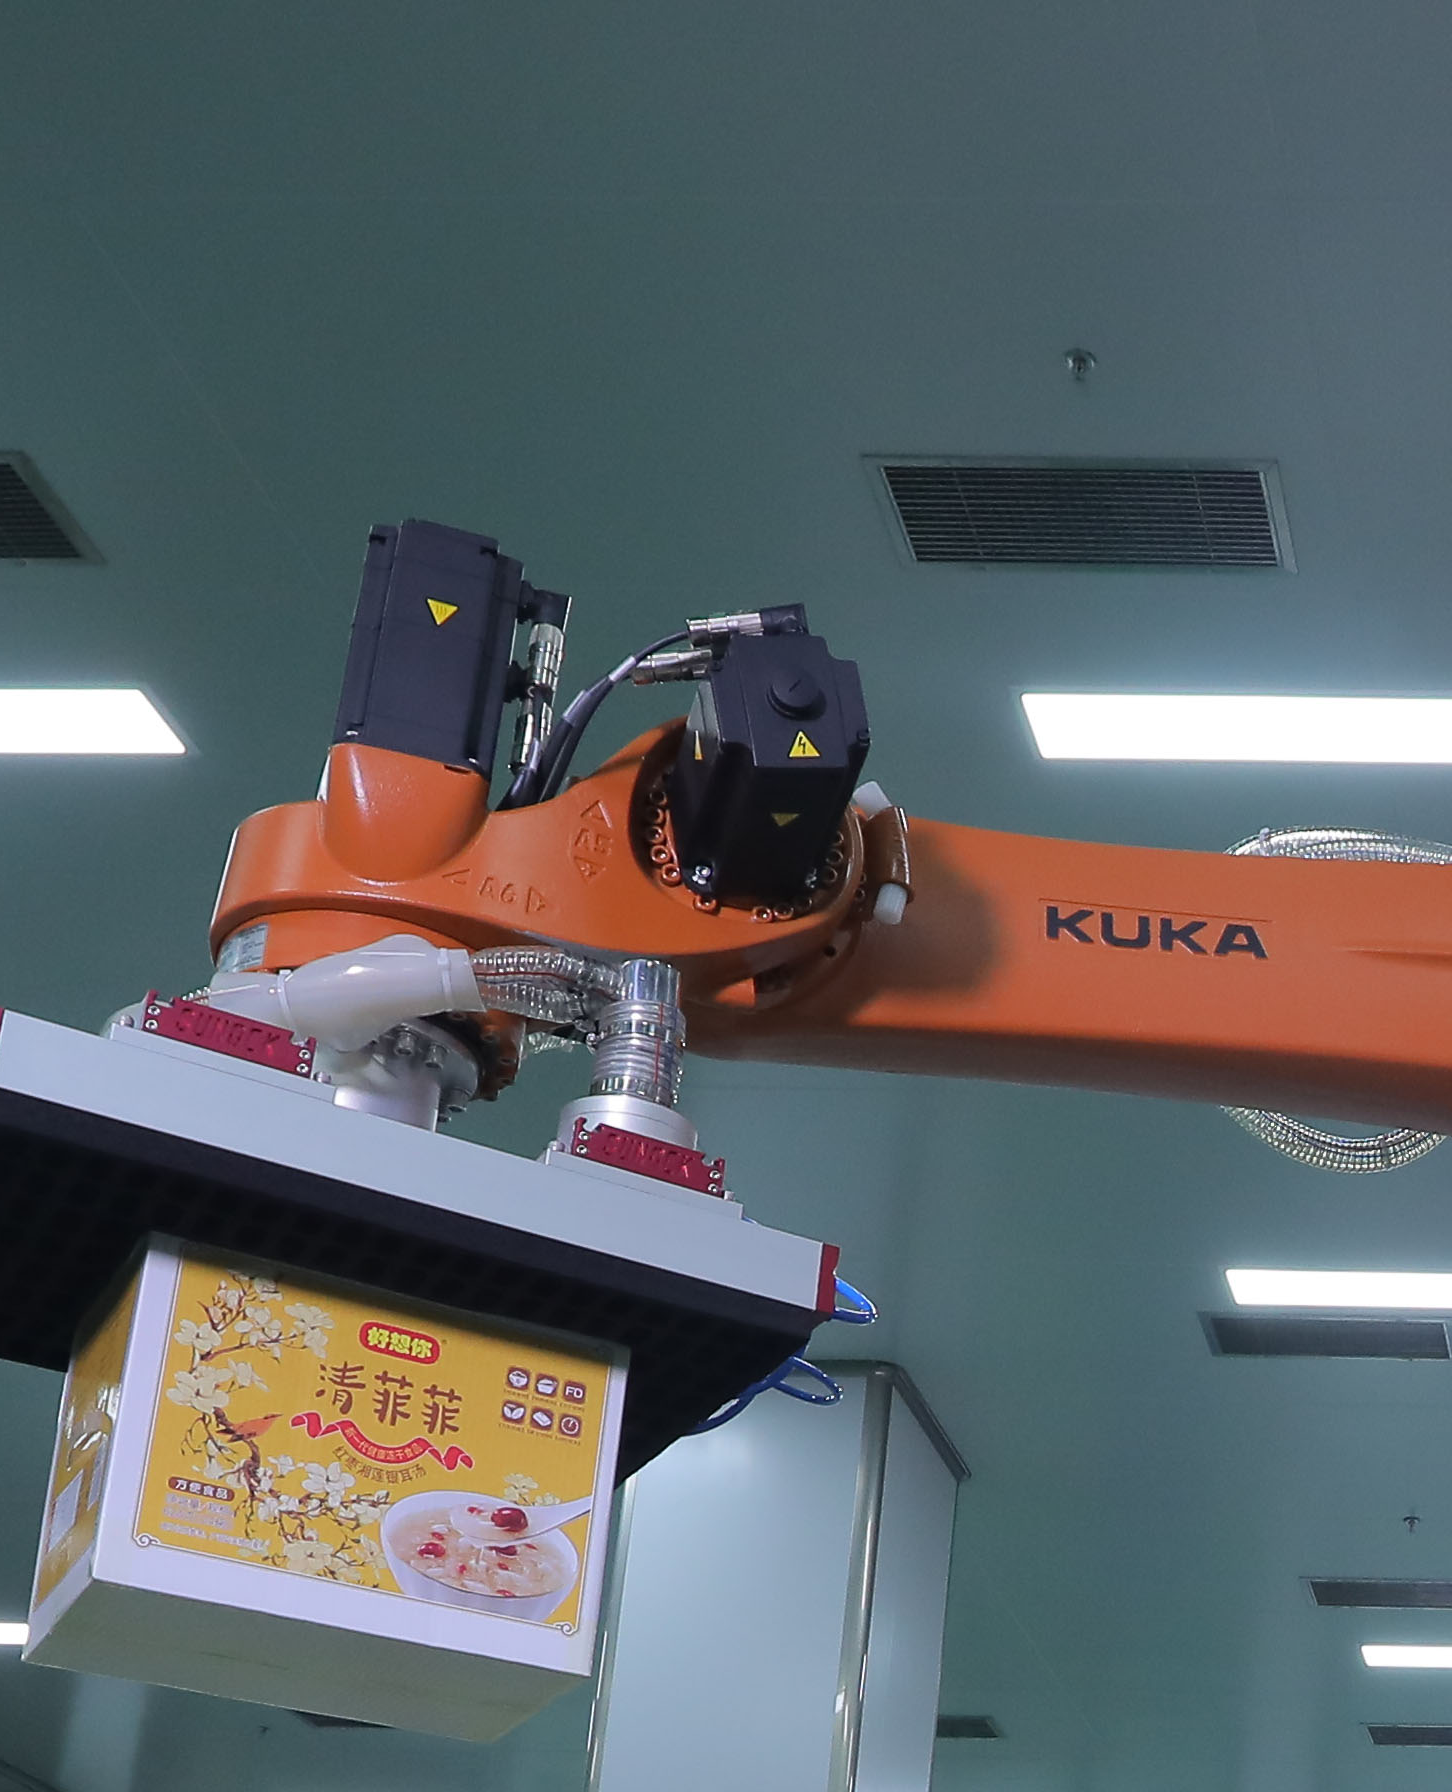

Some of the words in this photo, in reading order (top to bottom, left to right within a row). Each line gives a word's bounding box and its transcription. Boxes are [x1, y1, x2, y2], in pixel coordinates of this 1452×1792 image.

[1045, 905, 1268, 959] KUKA
[367, 1326, 434, 1359] 好想你
[315, 1361, 463, 1436] 清菲菲
[565, 1385, 584, 1400] FD
[175, 1479, 228, 1499] 方便食品
